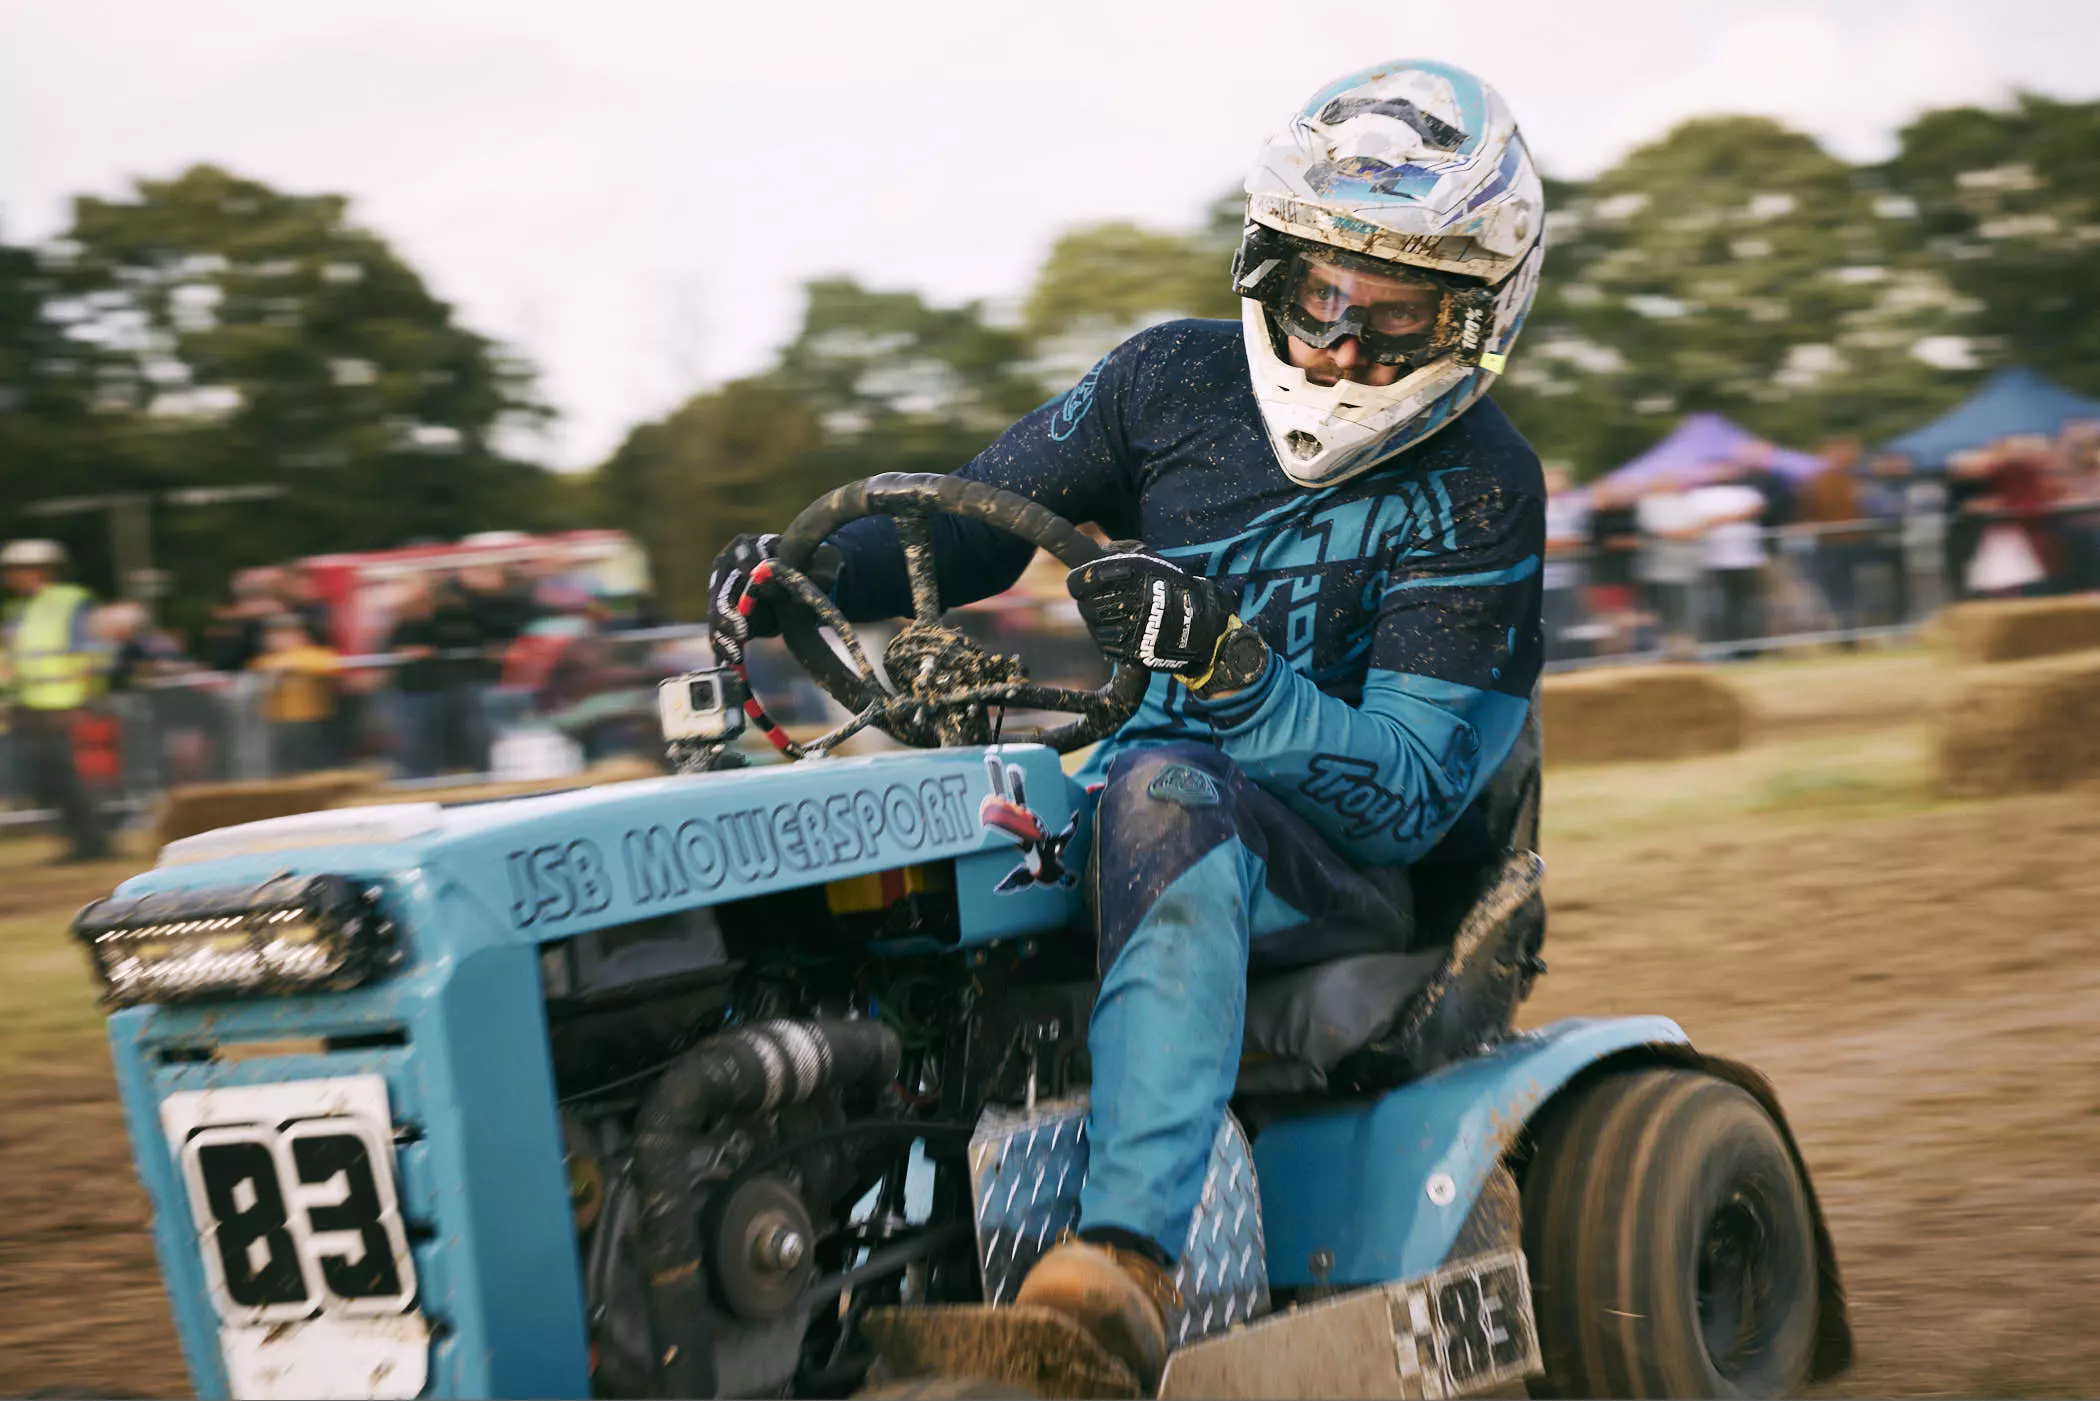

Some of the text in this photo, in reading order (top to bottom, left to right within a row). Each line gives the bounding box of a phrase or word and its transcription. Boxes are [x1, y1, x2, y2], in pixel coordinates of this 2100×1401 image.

[1462, 307, 1484, 350] 100%
[506, 773, 975, 928] JSB MOWERSPORT
[1300, 753, 1407, 838] Troy
[198, 1133, 402, 1306] 83
